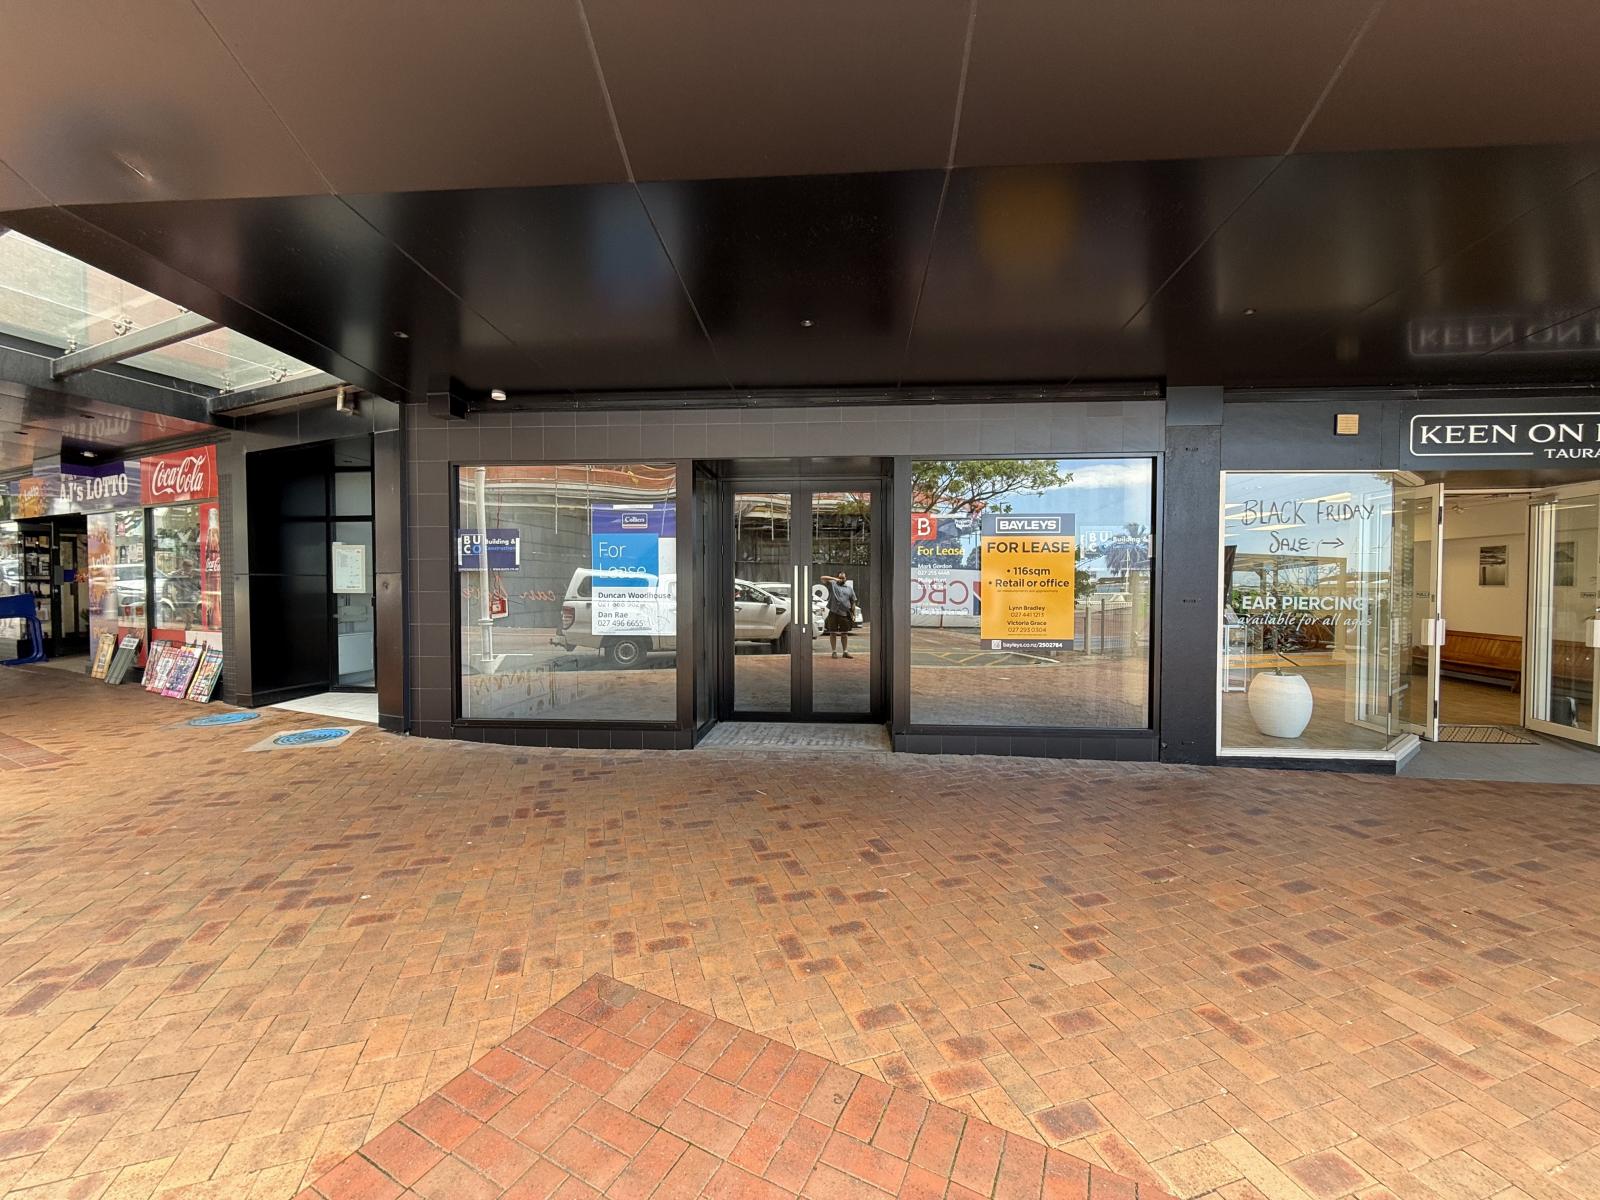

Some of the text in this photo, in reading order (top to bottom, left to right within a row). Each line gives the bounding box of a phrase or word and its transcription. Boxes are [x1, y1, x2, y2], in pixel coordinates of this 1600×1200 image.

[1420, 424, 1517, 444] KEEN
[1528, 423, 1584, 443] ON
[151, 454, 206, 496] Coca-Cola
[60, 474, 128, 503] AJ's LOTTO
[1241, 499, 1375, 526] BLACK FRIDAY
[1000, 520, 1056, 530] BAYLEYS
[987, 541, 1070, 553] FOR LEASE
[1269, 530, 1311, 553] SALE
[599, 541, 626, 558] For
[917, 545, 966, 556] For Lease
[1013, 566, 1051, 577] 116sqm
[995, 578, 1070, 588] Retail or office
[1242, 596, 1368, 611] EAR PIERCING
[598, 611, 629, 619] Dan Rae
[1238, 612, 1373, 632] available for all ages
[597, 619, 644, 627] 027 496 6655
